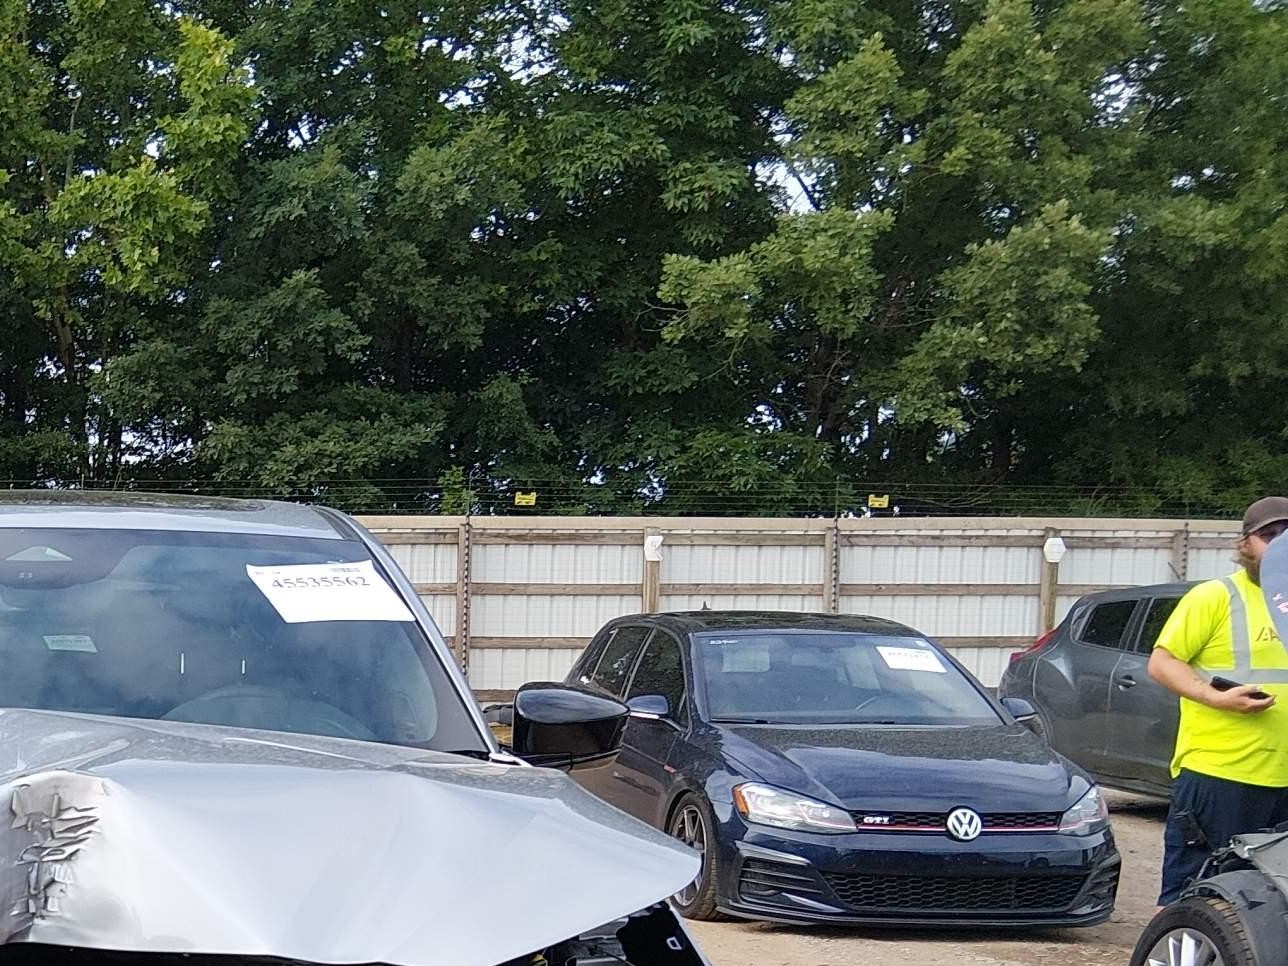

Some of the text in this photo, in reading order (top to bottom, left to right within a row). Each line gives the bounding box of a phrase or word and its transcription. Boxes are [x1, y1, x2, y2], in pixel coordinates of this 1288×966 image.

[271, 576, 372, 590] 45535562
[863, 815, 891, 825] GTI
[947, 808, 982, 841] VW
